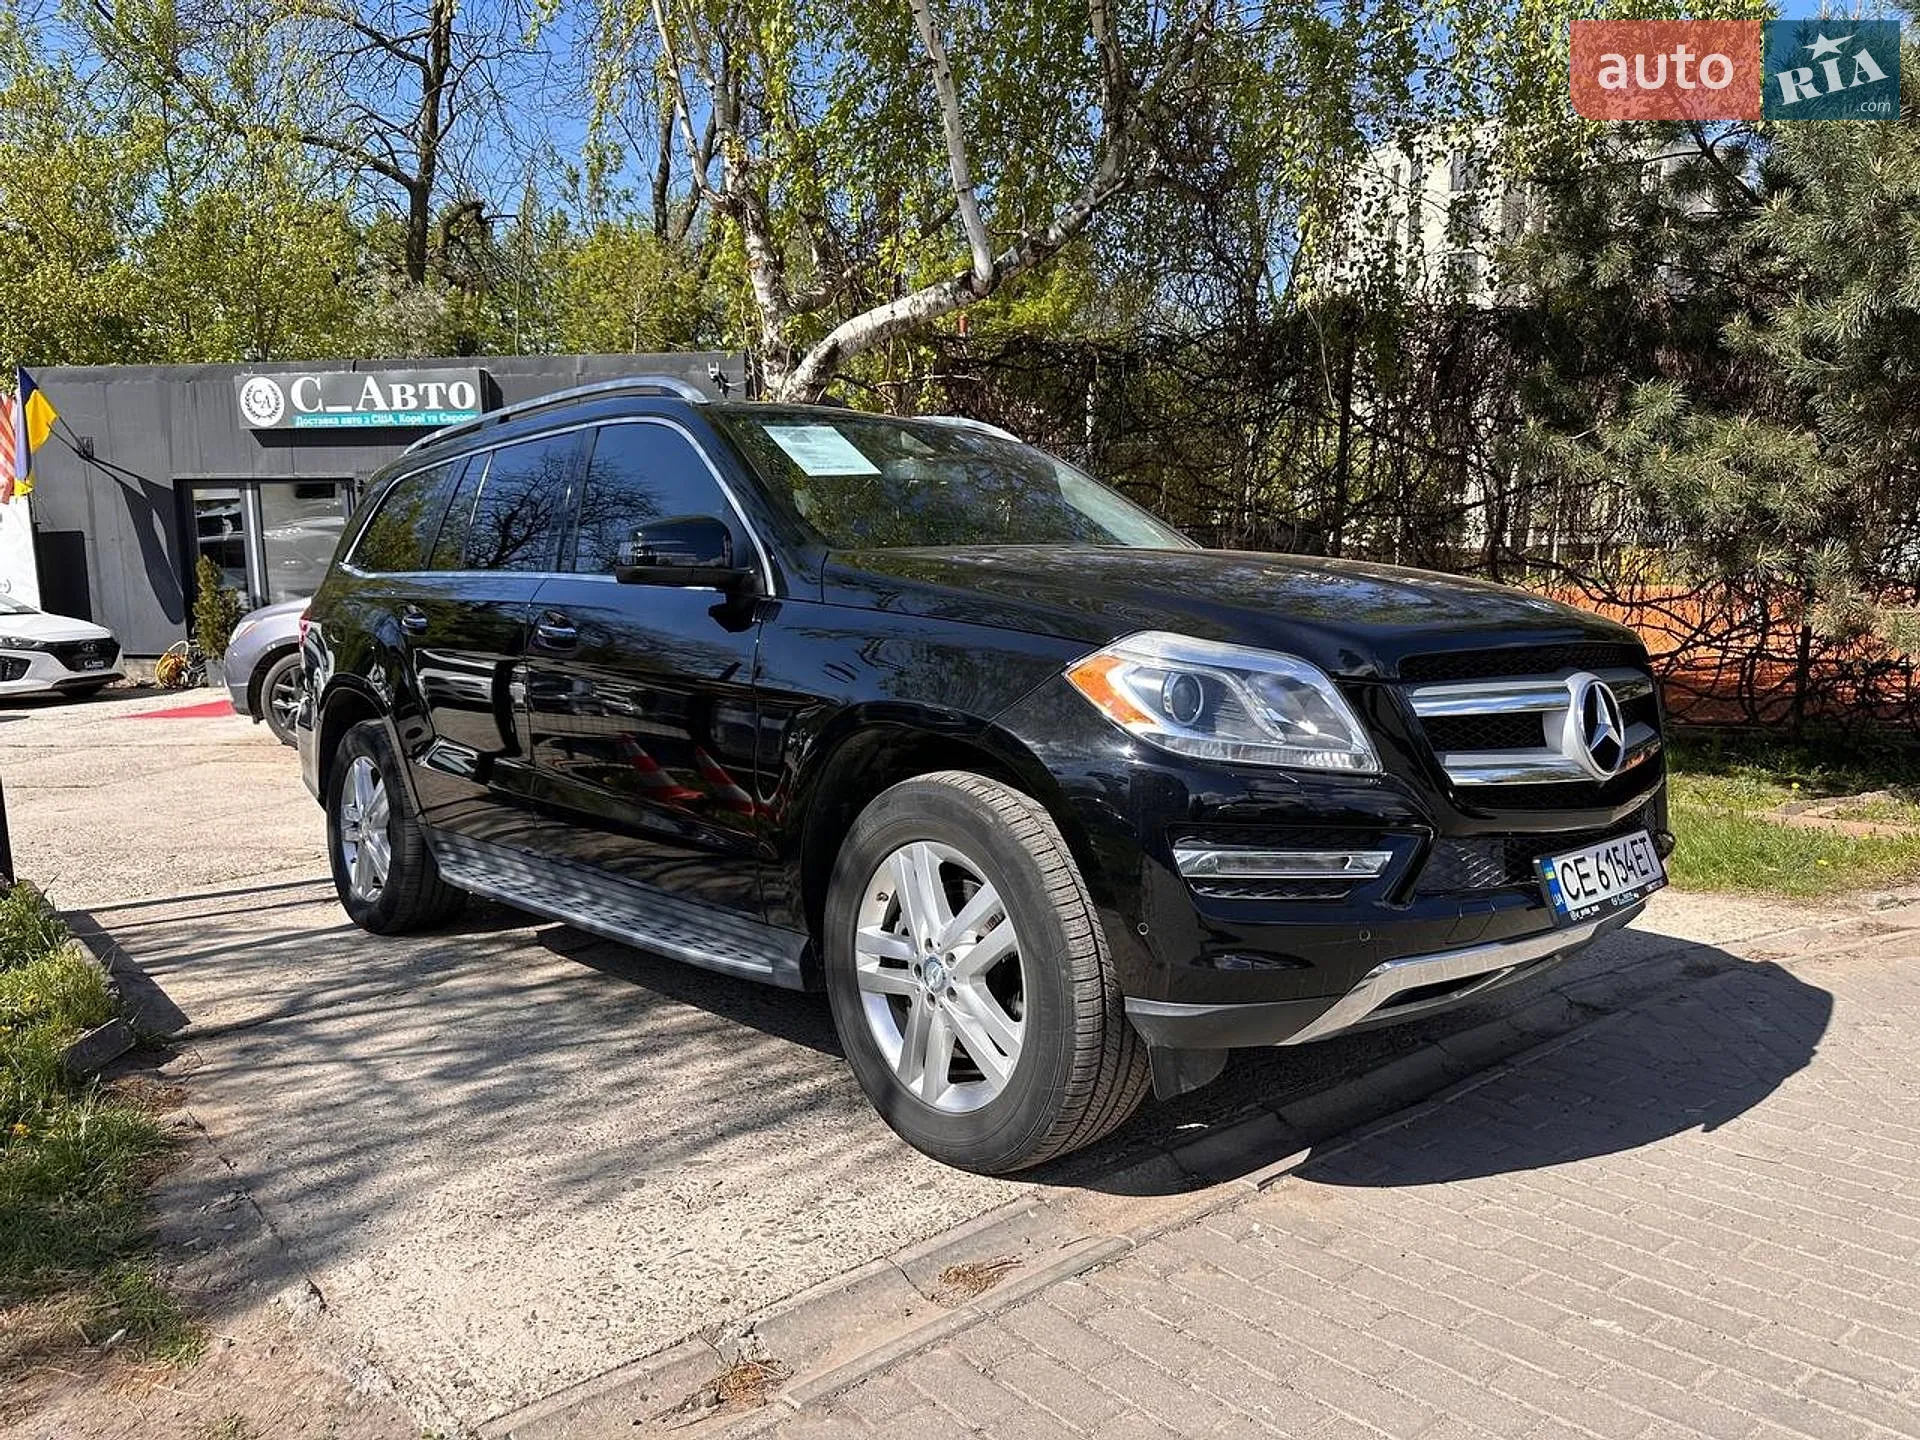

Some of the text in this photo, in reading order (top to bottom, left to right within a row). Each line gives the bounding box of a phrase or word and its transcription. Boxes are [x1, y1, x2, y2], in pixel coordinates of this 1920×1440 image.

[295, 415, 339, 427] Доставка
[341, 416, 363, 426] авто
[427, 413, 438, 424] та
